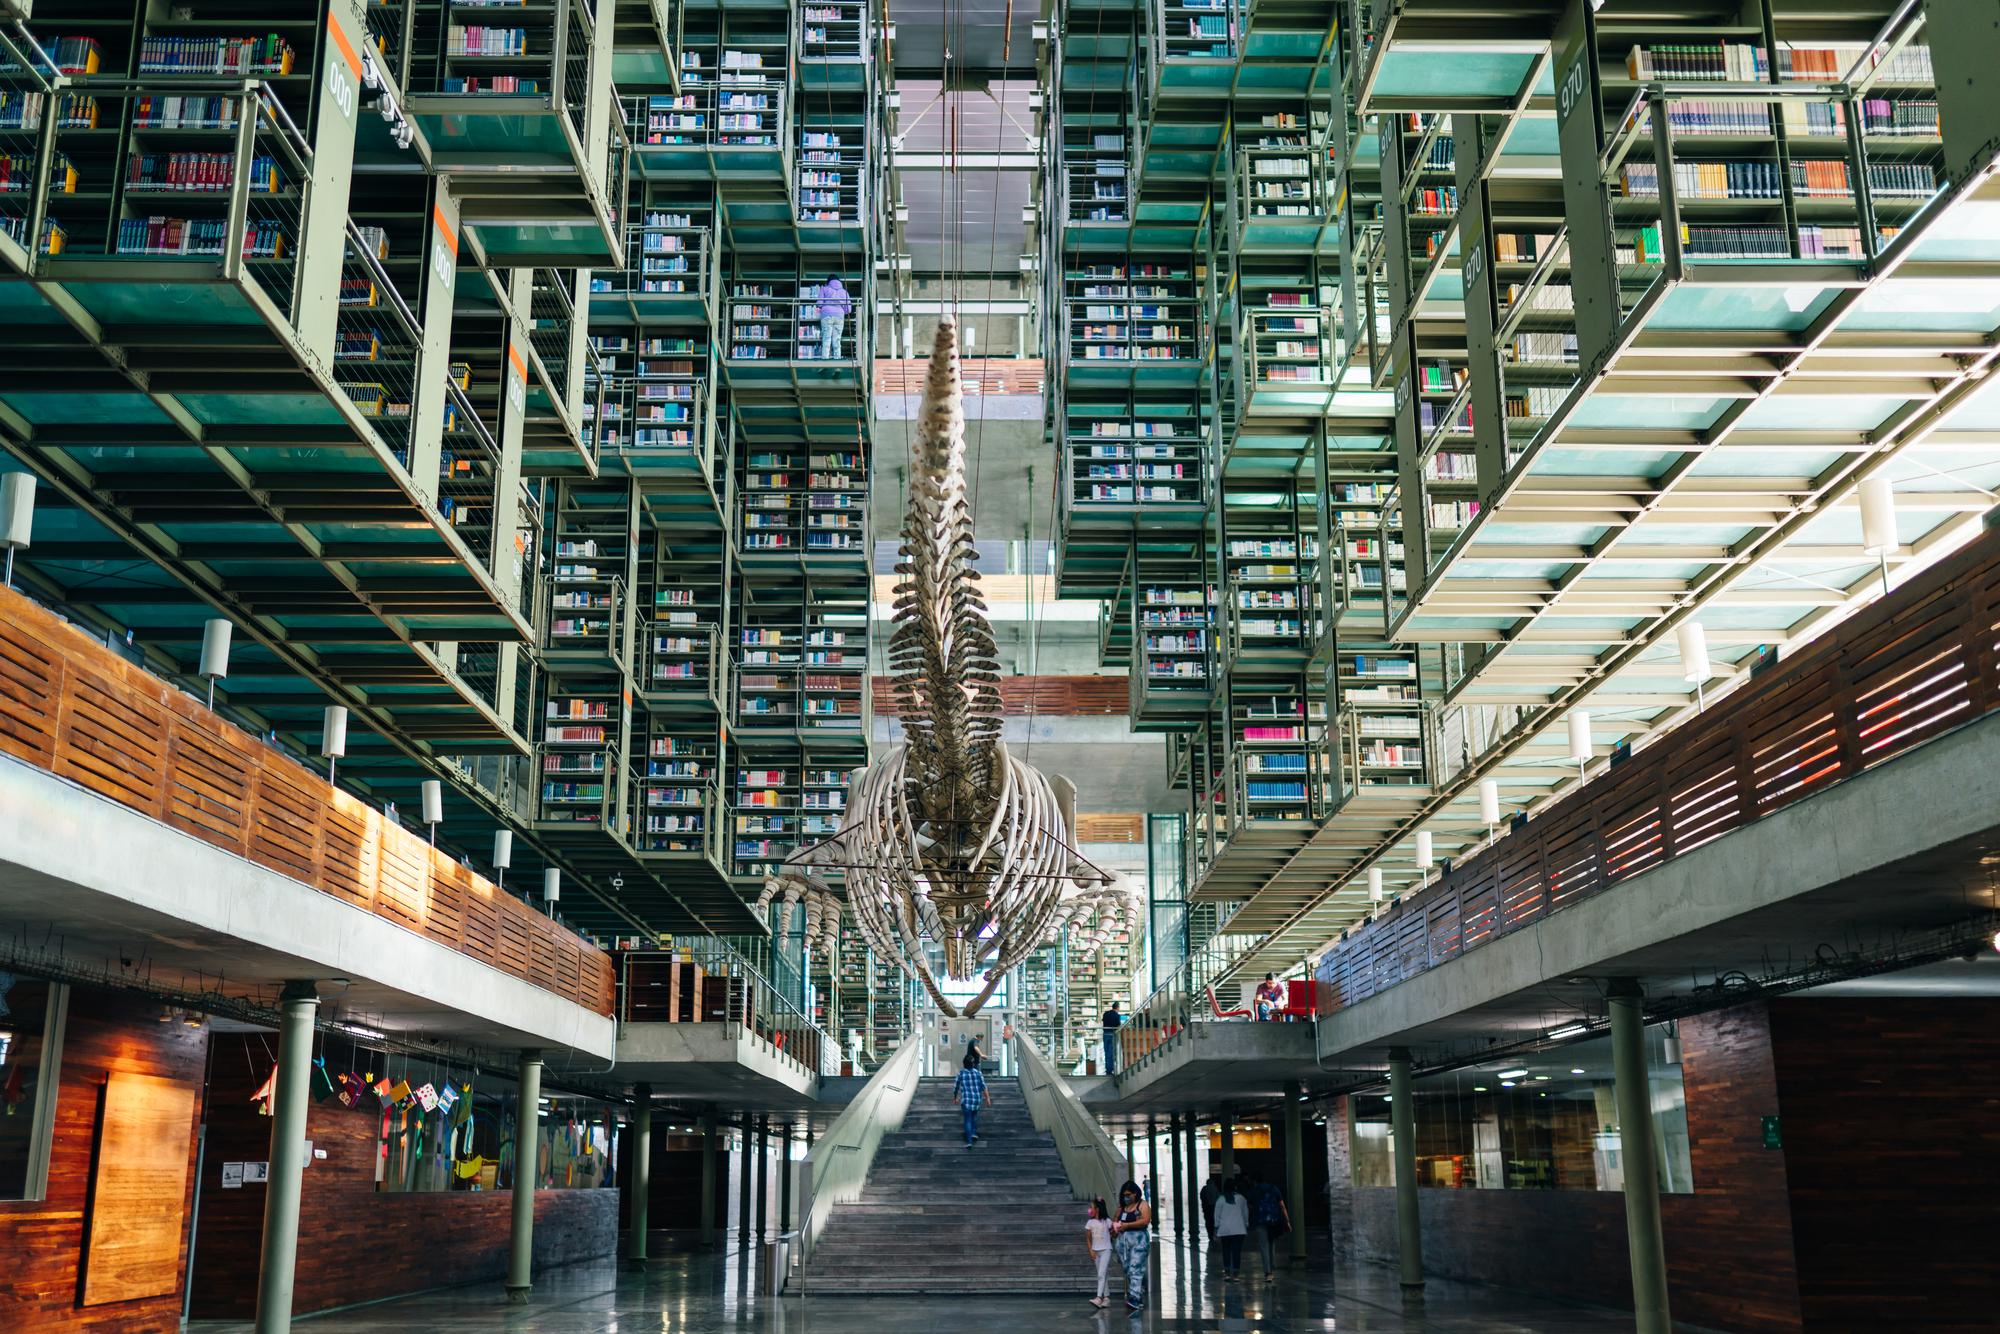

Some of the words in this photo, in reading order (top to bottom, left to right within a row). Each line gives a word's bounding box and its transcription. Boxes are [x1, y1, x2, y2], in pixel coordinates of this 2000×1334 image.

[330, 61, 352, 118] 000
[1561, 62, 1583, 118] 970
[435, 244, 451, 289] 000
[1466, 246, 1481, 289] 970
[1396, 376, 1409, 412] 970
